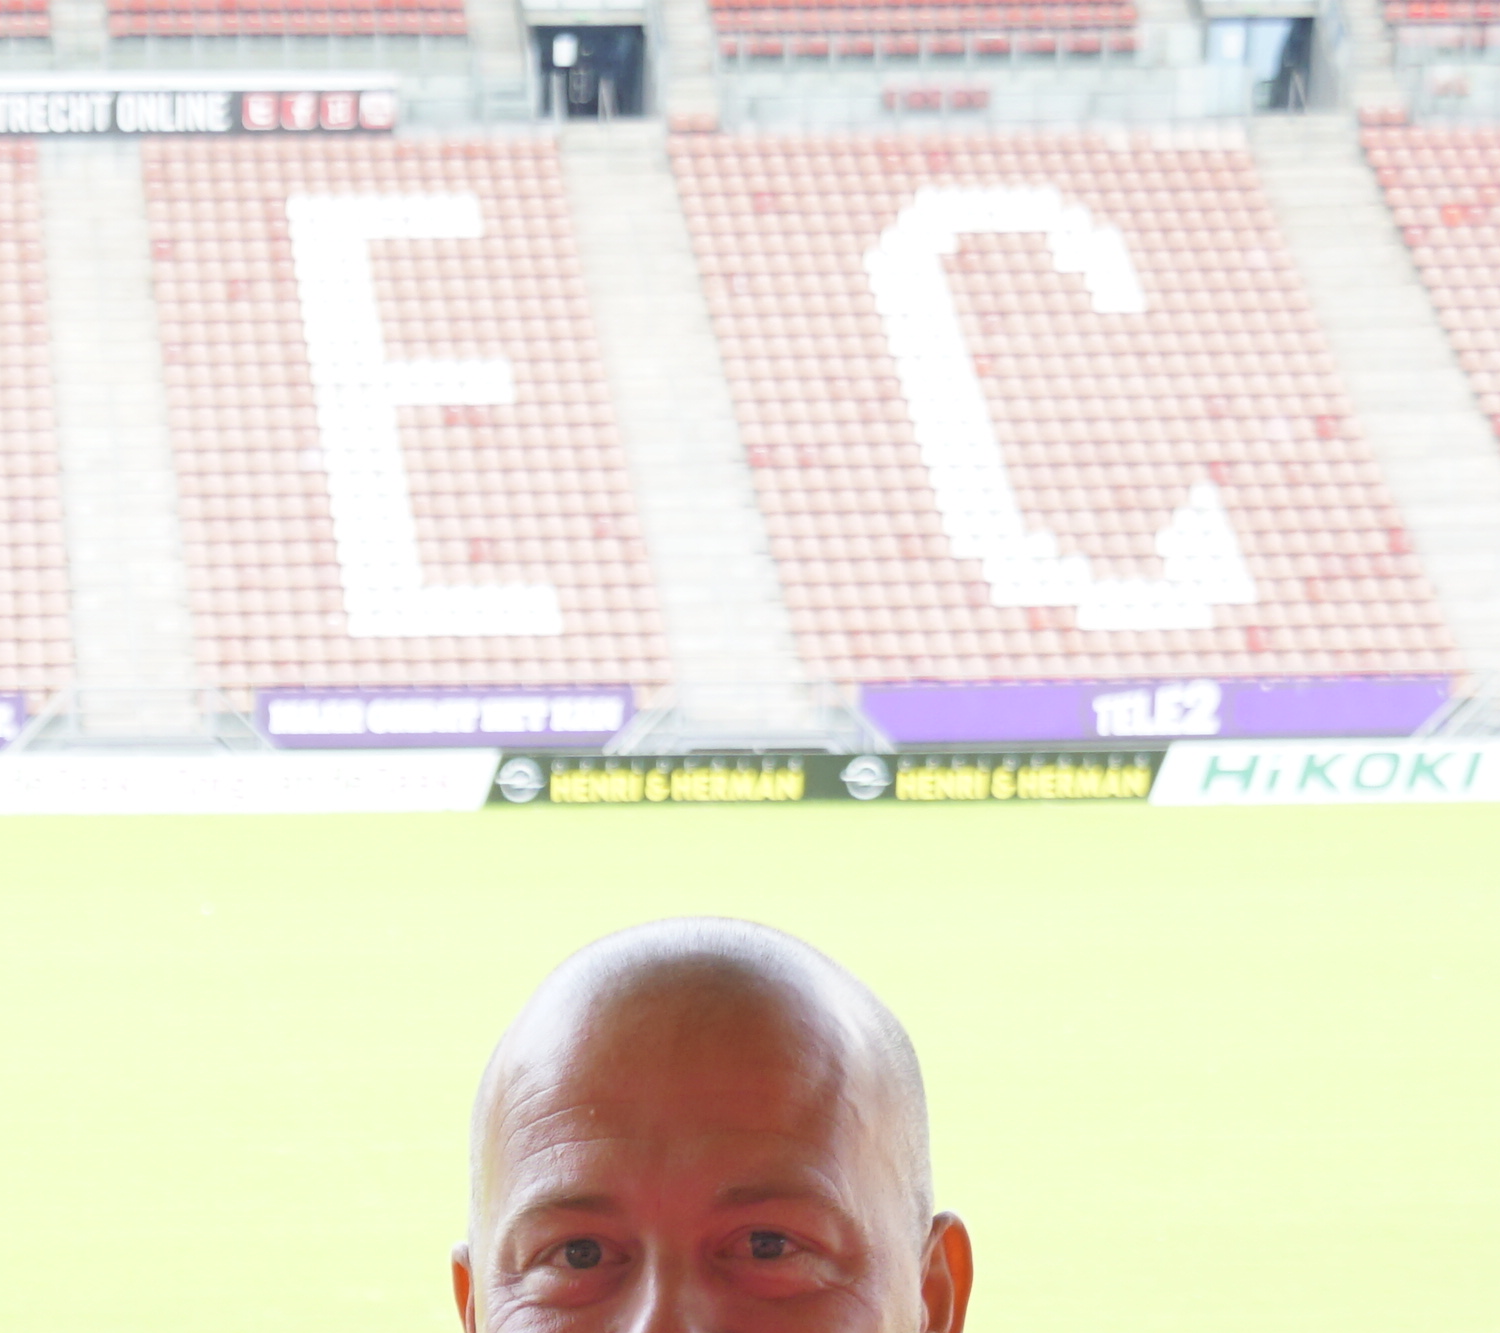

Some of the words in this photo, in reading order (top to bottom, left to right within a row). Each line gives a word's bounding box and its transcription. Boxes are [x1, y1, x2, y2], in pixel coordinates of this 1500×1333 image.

[116, 91, 232, 135] ONLINE
[1093, 679, 1223, 737] TELE2
[671, 768, 805, 803] HERMAN
